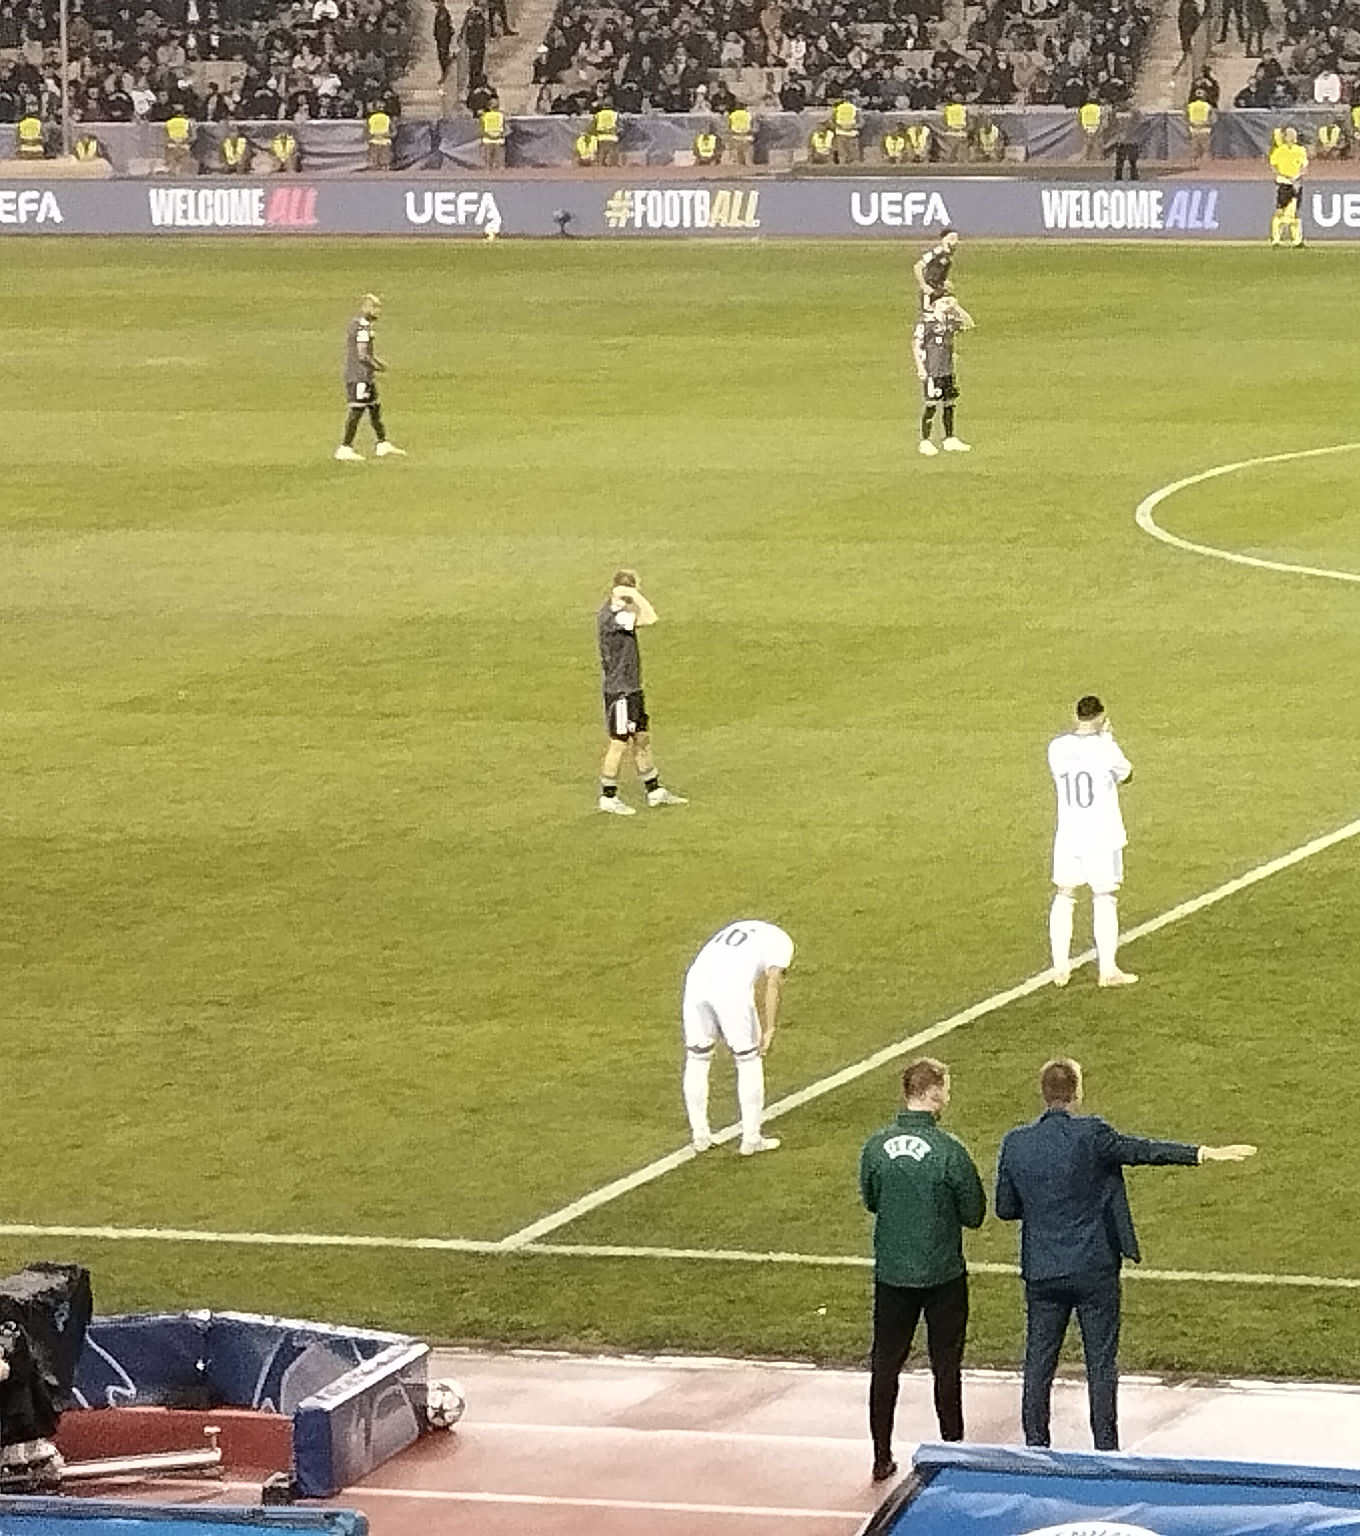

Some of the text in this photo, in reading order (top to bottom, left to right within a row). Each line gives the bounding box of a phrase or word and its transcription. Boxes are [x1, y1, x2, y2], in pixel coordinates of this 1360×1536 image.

[0, 191, 63, 223] EFA
[149, 188, 319, 226] WELCOME ALL
[405, 192, 500, 224] UEFA
[604, 190, 760, 228] #FOOTBALL
[851, 192, 950, 226] UEFA
[1041, 190, 1219, 229] WELCOME ALL
[1060, 770, 1095, 809] 10
